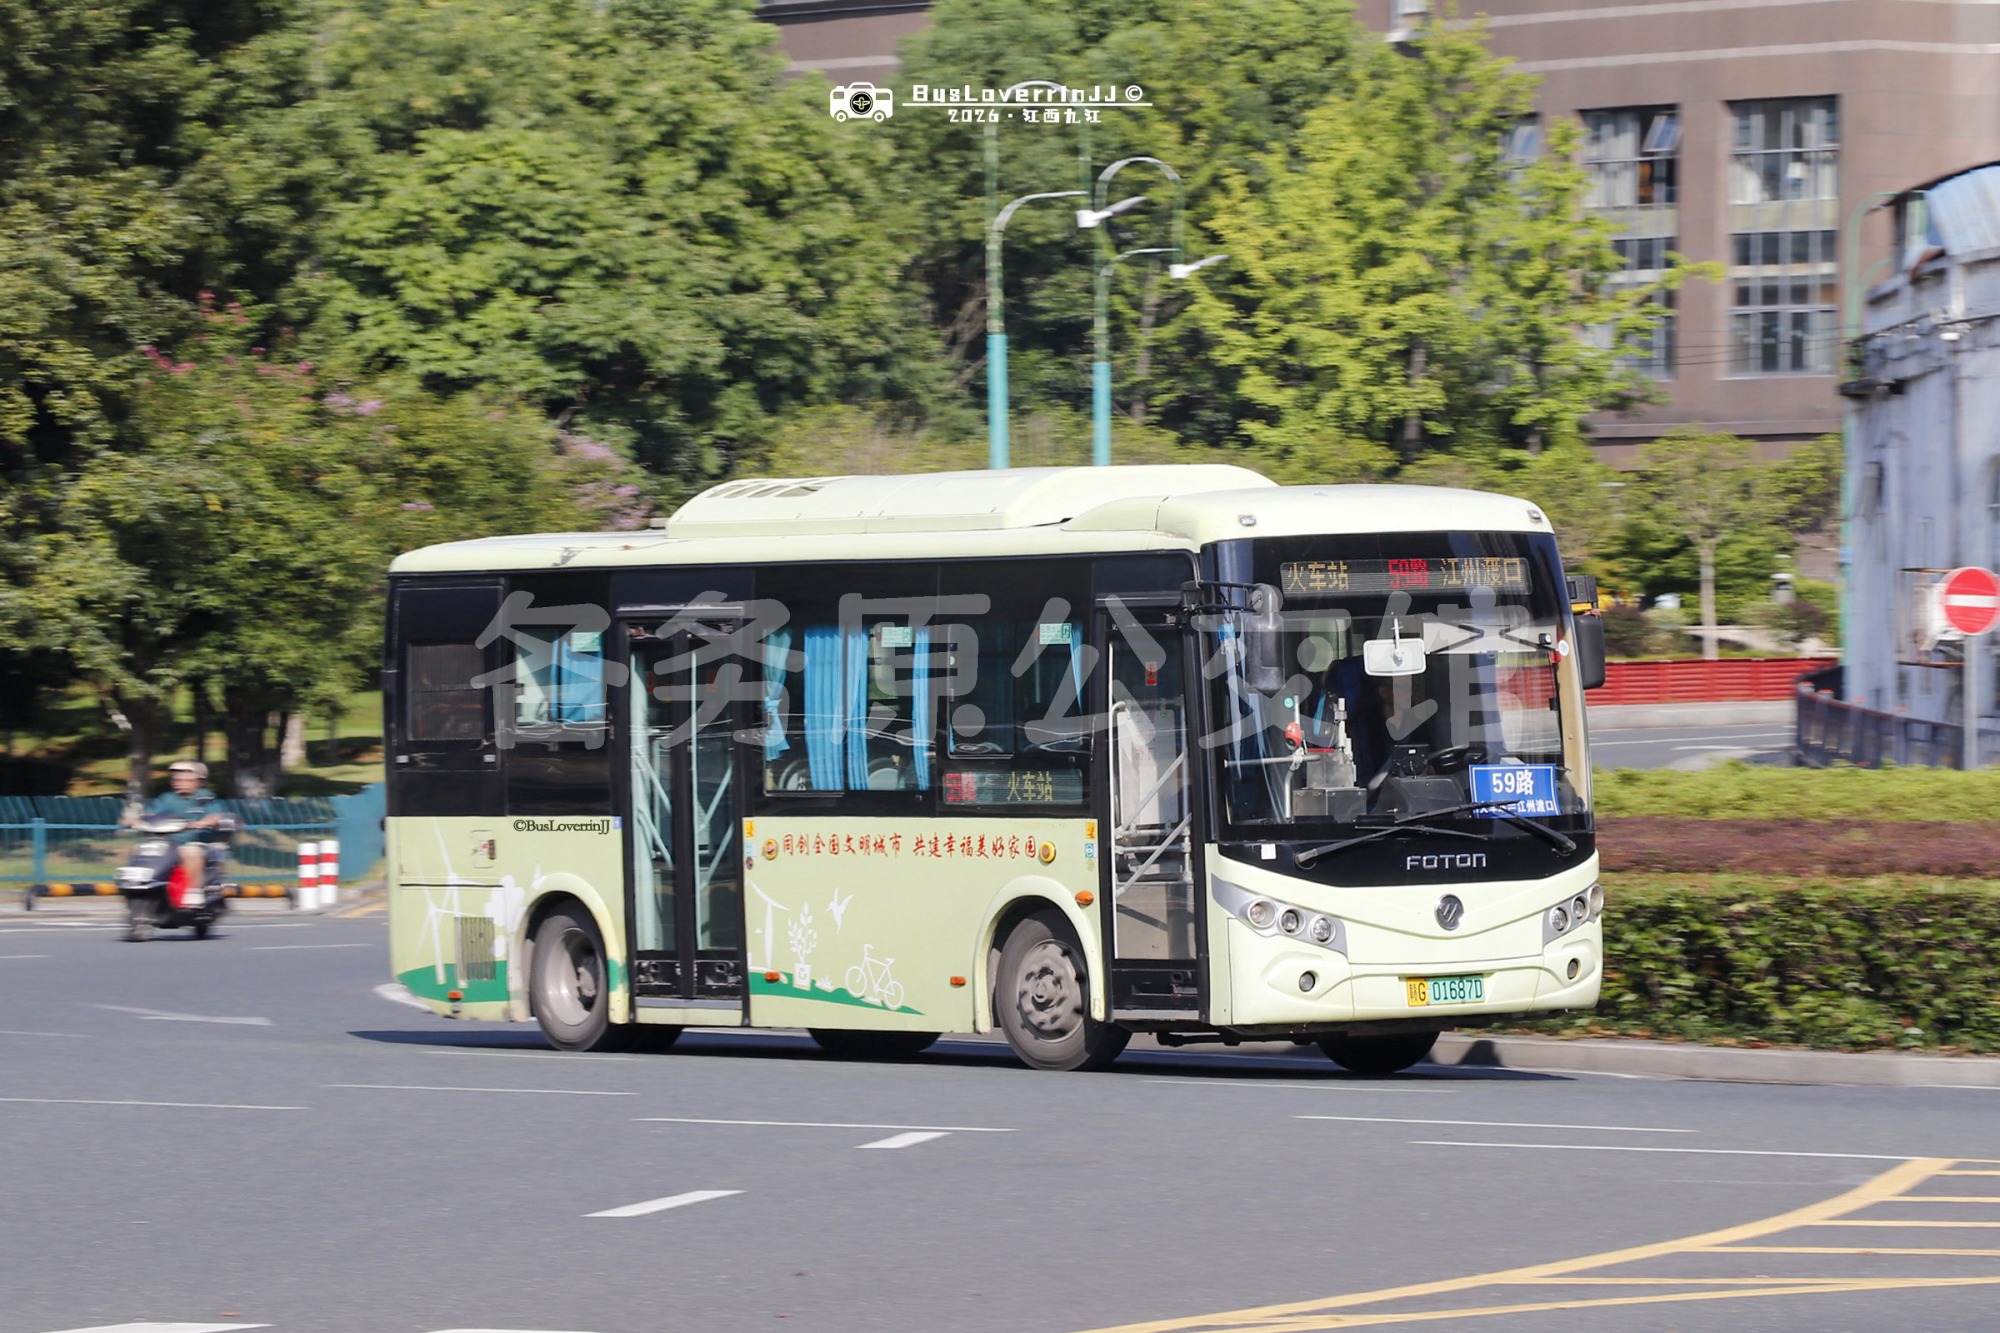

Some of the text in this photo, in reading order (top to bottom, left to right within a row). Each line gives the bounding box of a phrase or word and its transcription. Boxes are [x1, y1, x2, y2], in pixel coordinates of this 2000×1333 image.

[1287, 556, 1522, 592] 火车站 59路 江州渡口
[1006, 770, 1054, 802] 火车站
[1491, 769, 1534, 796] 59路
[782, 831, 1037, 860] 同创全国文明城市 共建幸福美好家园
[1405, 853, 1488, 871] FOTON
